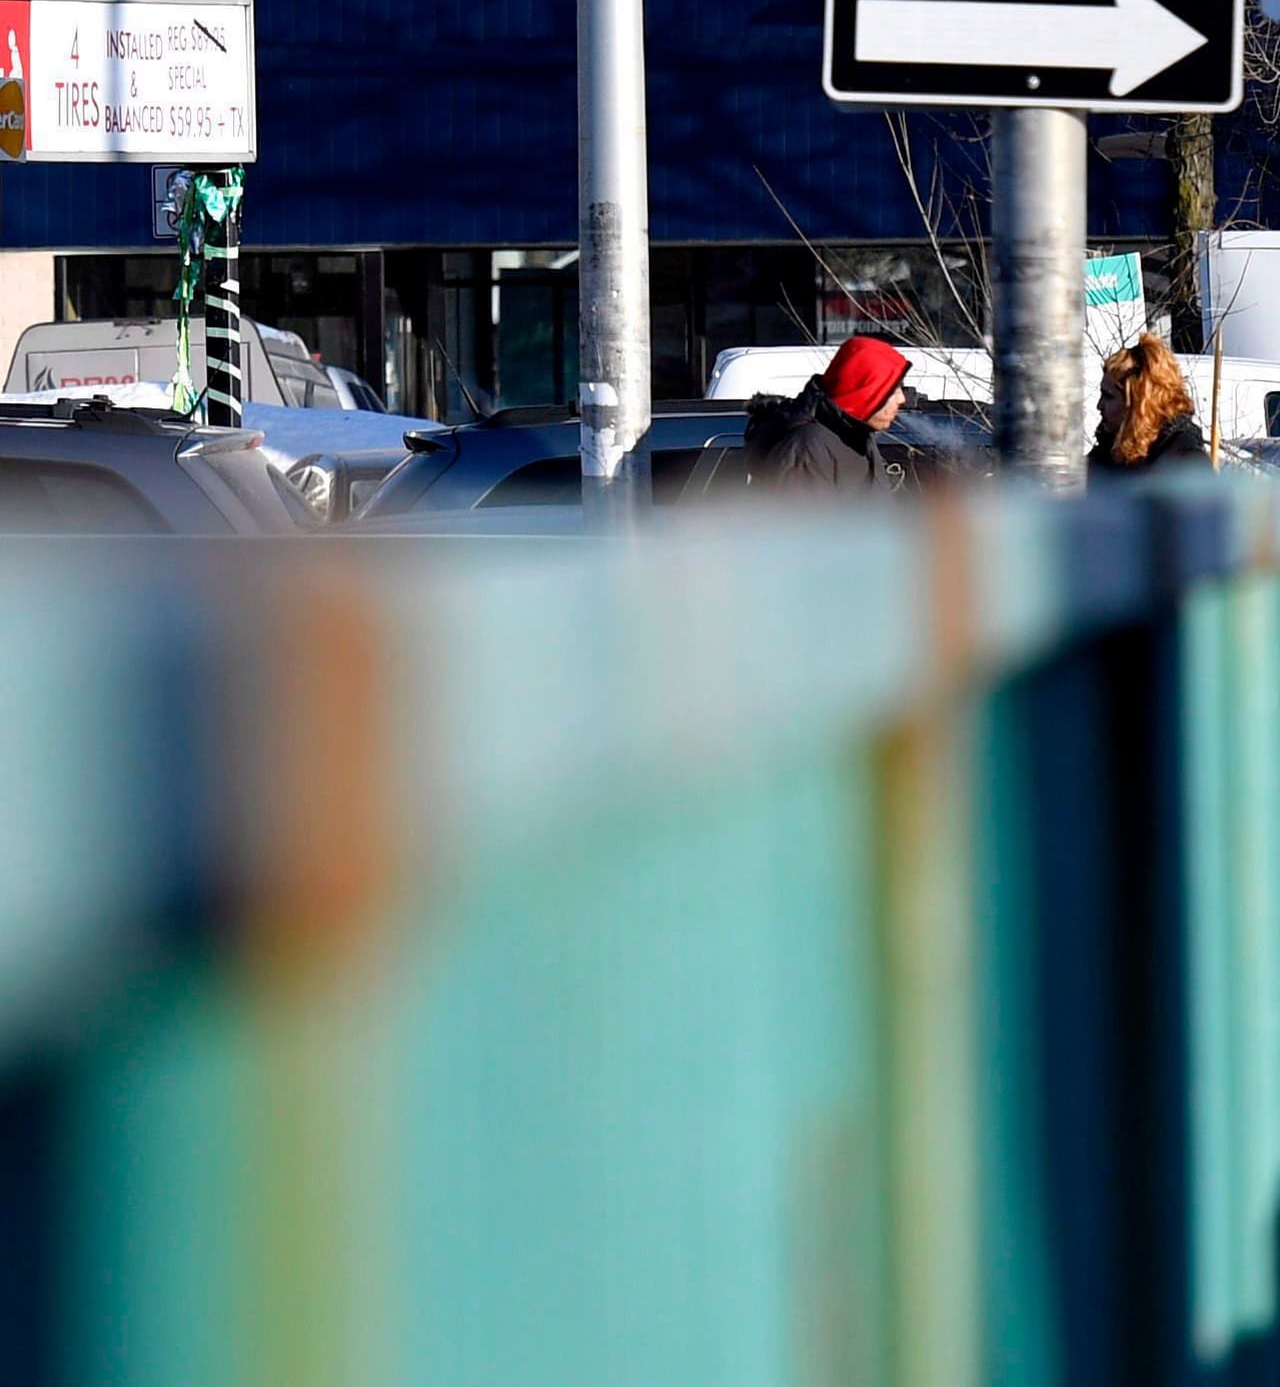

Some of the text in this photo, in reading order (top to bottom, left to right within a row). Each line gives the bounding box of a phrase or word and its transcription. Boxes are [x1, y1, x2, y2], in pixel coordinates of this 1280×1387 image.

[70, 27, 80, 70] 4
[106, 29, 163, 61] INSTALLED
[168, 26, 187, 51] REG
[130, 71, 138, 98] &
[168, 66, 207, 90] SPECIAL
[55, 82, 100, 127] TIRES
[105, 105, 164, 133] BALANCED
[170, 107, 212, 137] $59.95
[230, 107, 245, 138] TX
